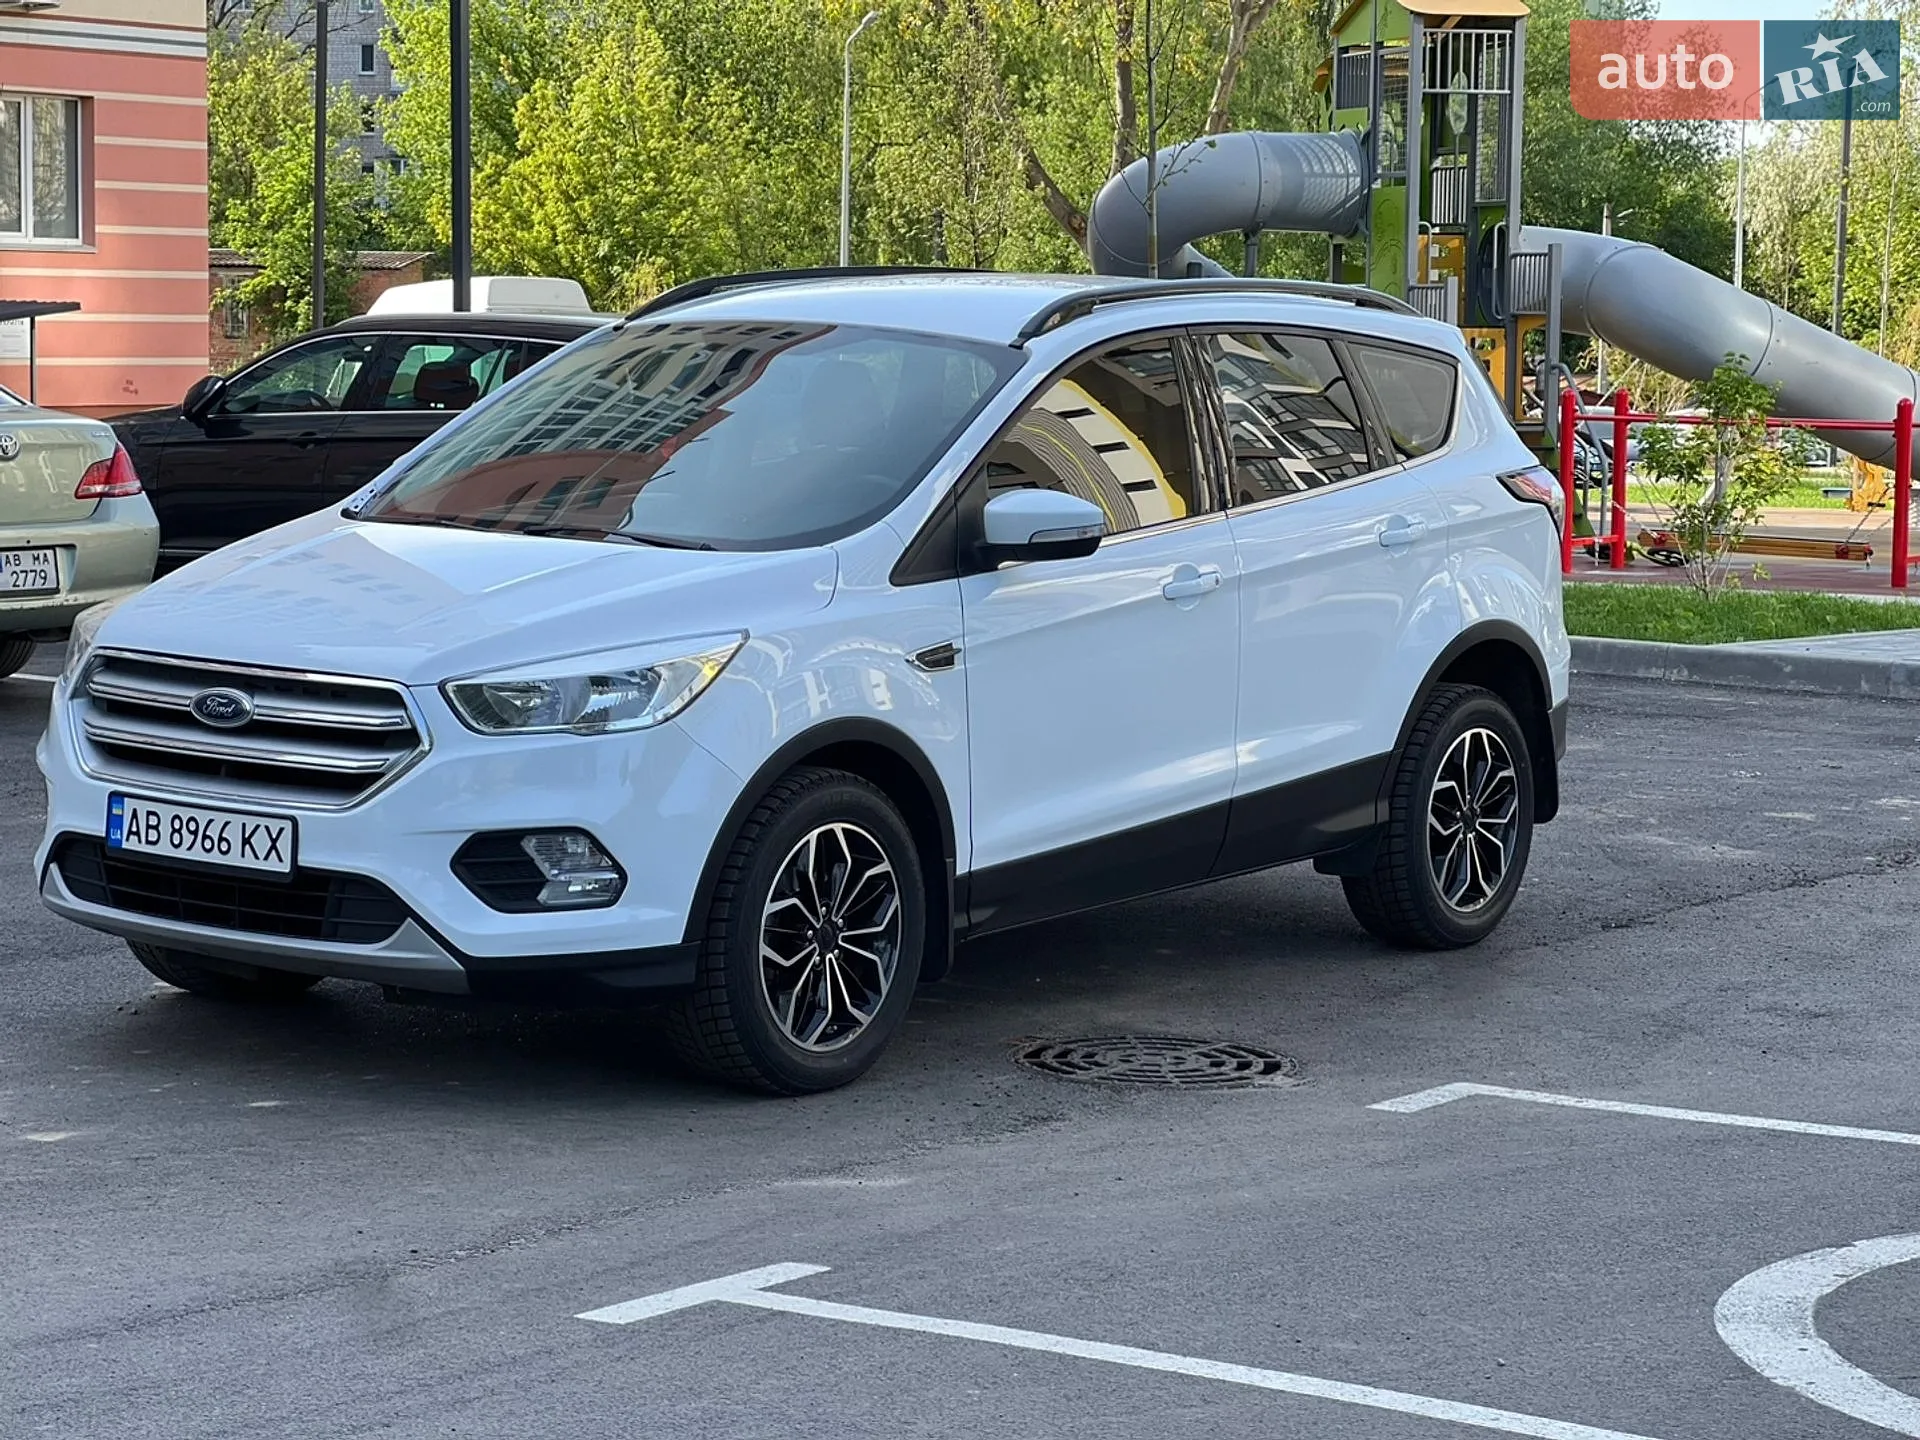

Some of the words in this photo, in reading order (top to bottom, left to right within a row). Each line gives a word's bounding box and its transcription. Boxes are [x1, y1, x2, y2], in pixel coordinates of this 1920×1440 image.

[5, 554, 21, 567] AB
[32, 552, 49, 565] MA
[11, 569, 47, 588] 2779
[203, 696, 235, 716] Ford
[110, 828, 122, 840] UA
[125, 807, 161, 846] AB
[169, 813, 232, 856] 8966
[241, 821, 285, 863] KX
